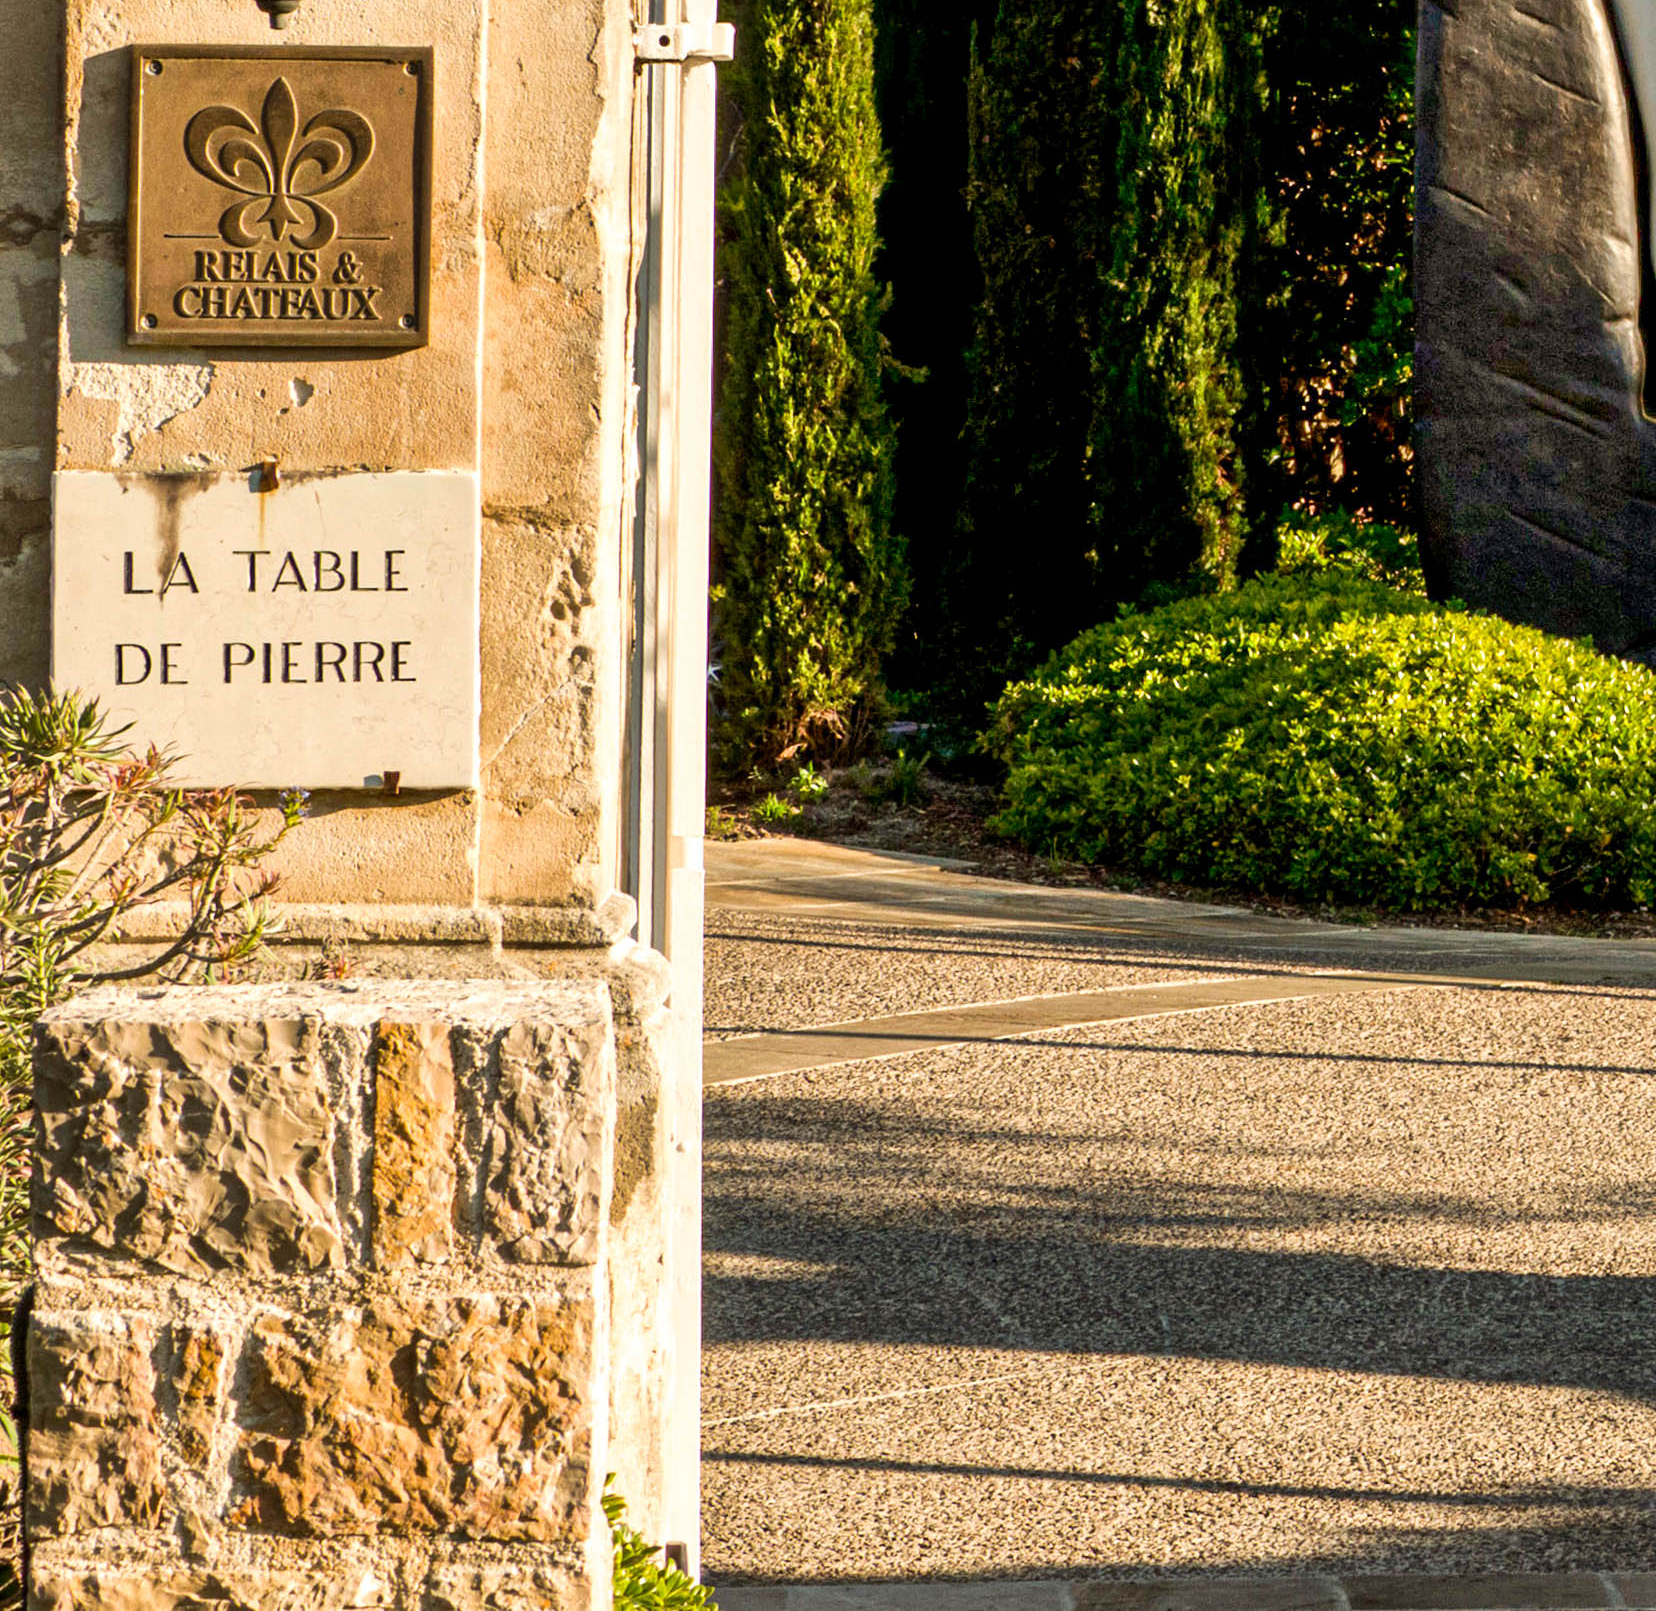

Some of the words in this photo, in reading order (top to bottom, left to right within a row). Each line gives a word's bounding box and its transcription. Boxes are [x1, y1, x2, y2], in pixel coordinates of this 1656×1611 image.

[193, 250, 320, 283] RELAIS
[332, 251, 364, 284] &
[173, 286, 383, 320] CHATEAUX
[124, 551, 199, 594] LA
[232, 550, 409, 593] TABLE
[115, 643, 188, 685] DE
[223, 641, 416, 684] PIERRE
